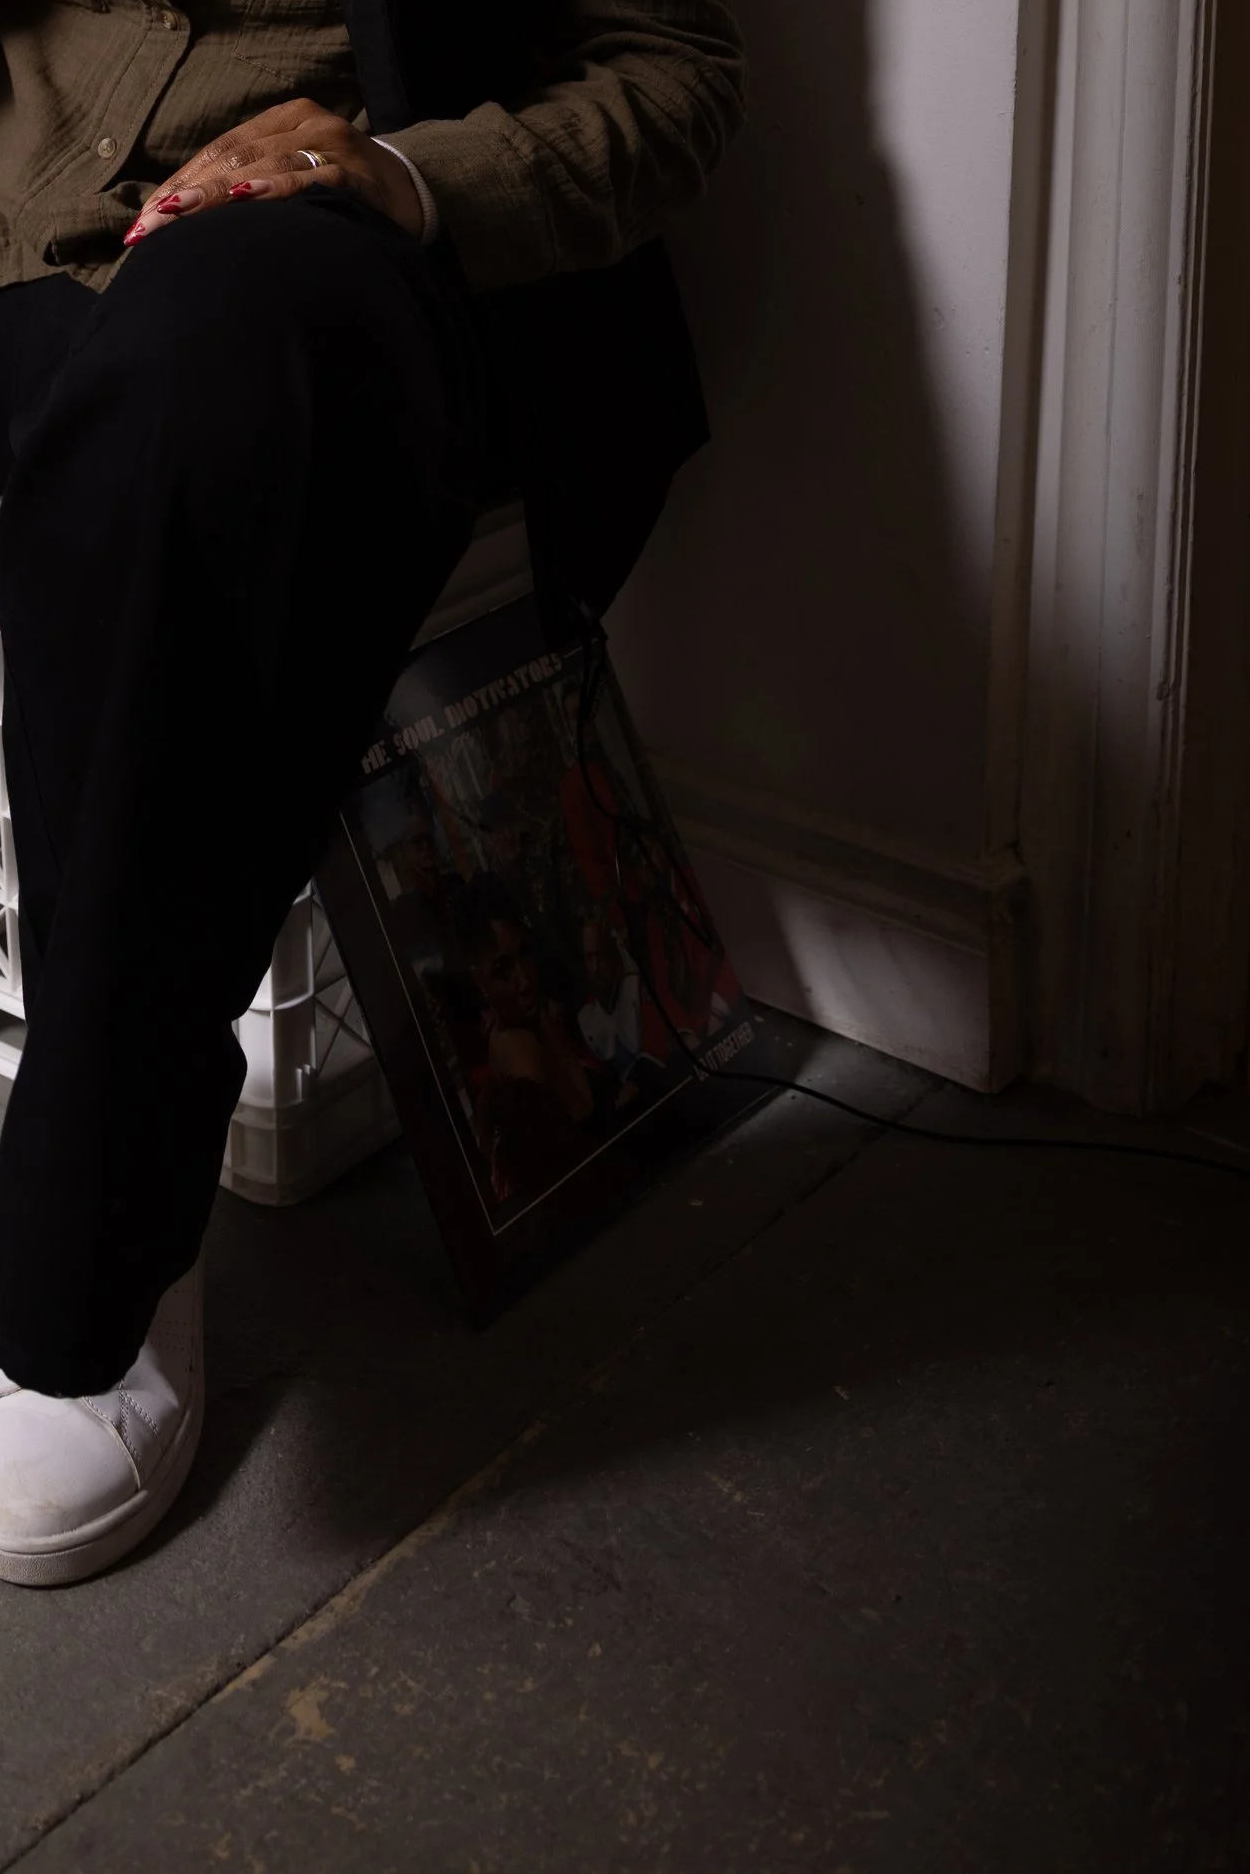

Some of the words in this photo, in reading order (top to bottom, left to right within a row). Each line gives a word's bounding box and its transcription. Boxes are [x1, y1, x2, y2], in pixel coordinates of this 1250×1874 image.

[360, 738, 394, 777] HE
[393, 714, 447, 757] SOUL
[442, 652, 564, 730] MOTIVATORS
[712, 1021, 757, 1069] TOGETHER
